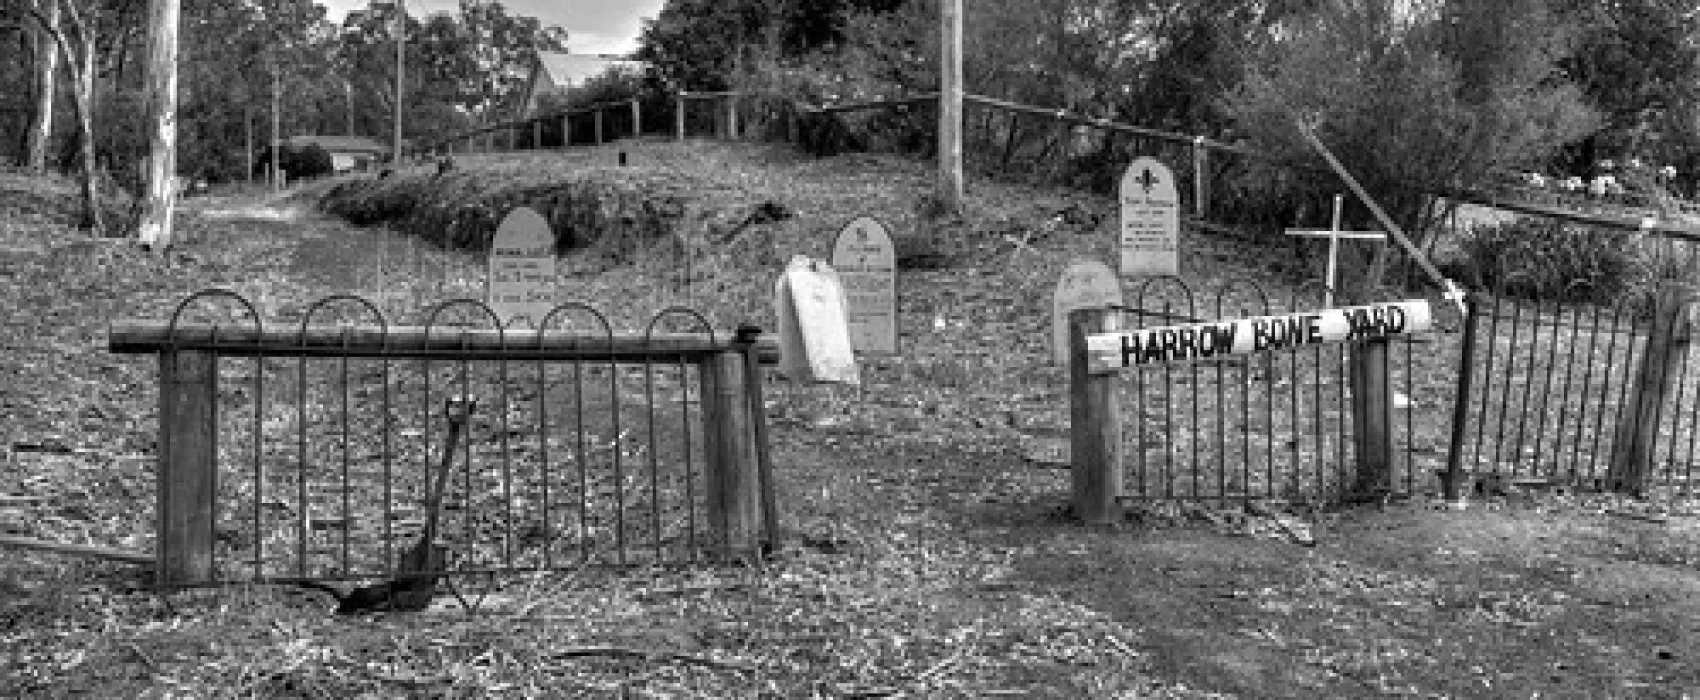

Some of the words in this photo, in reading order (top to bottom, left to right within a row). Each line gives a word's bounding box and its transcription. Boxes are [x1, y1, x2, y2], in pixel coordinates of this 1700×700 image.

[1121, 324, 1235, 367] HARROW
[1254, 316, 1323, 349] BONE
[1346, 306, 1405, 338] YARD
